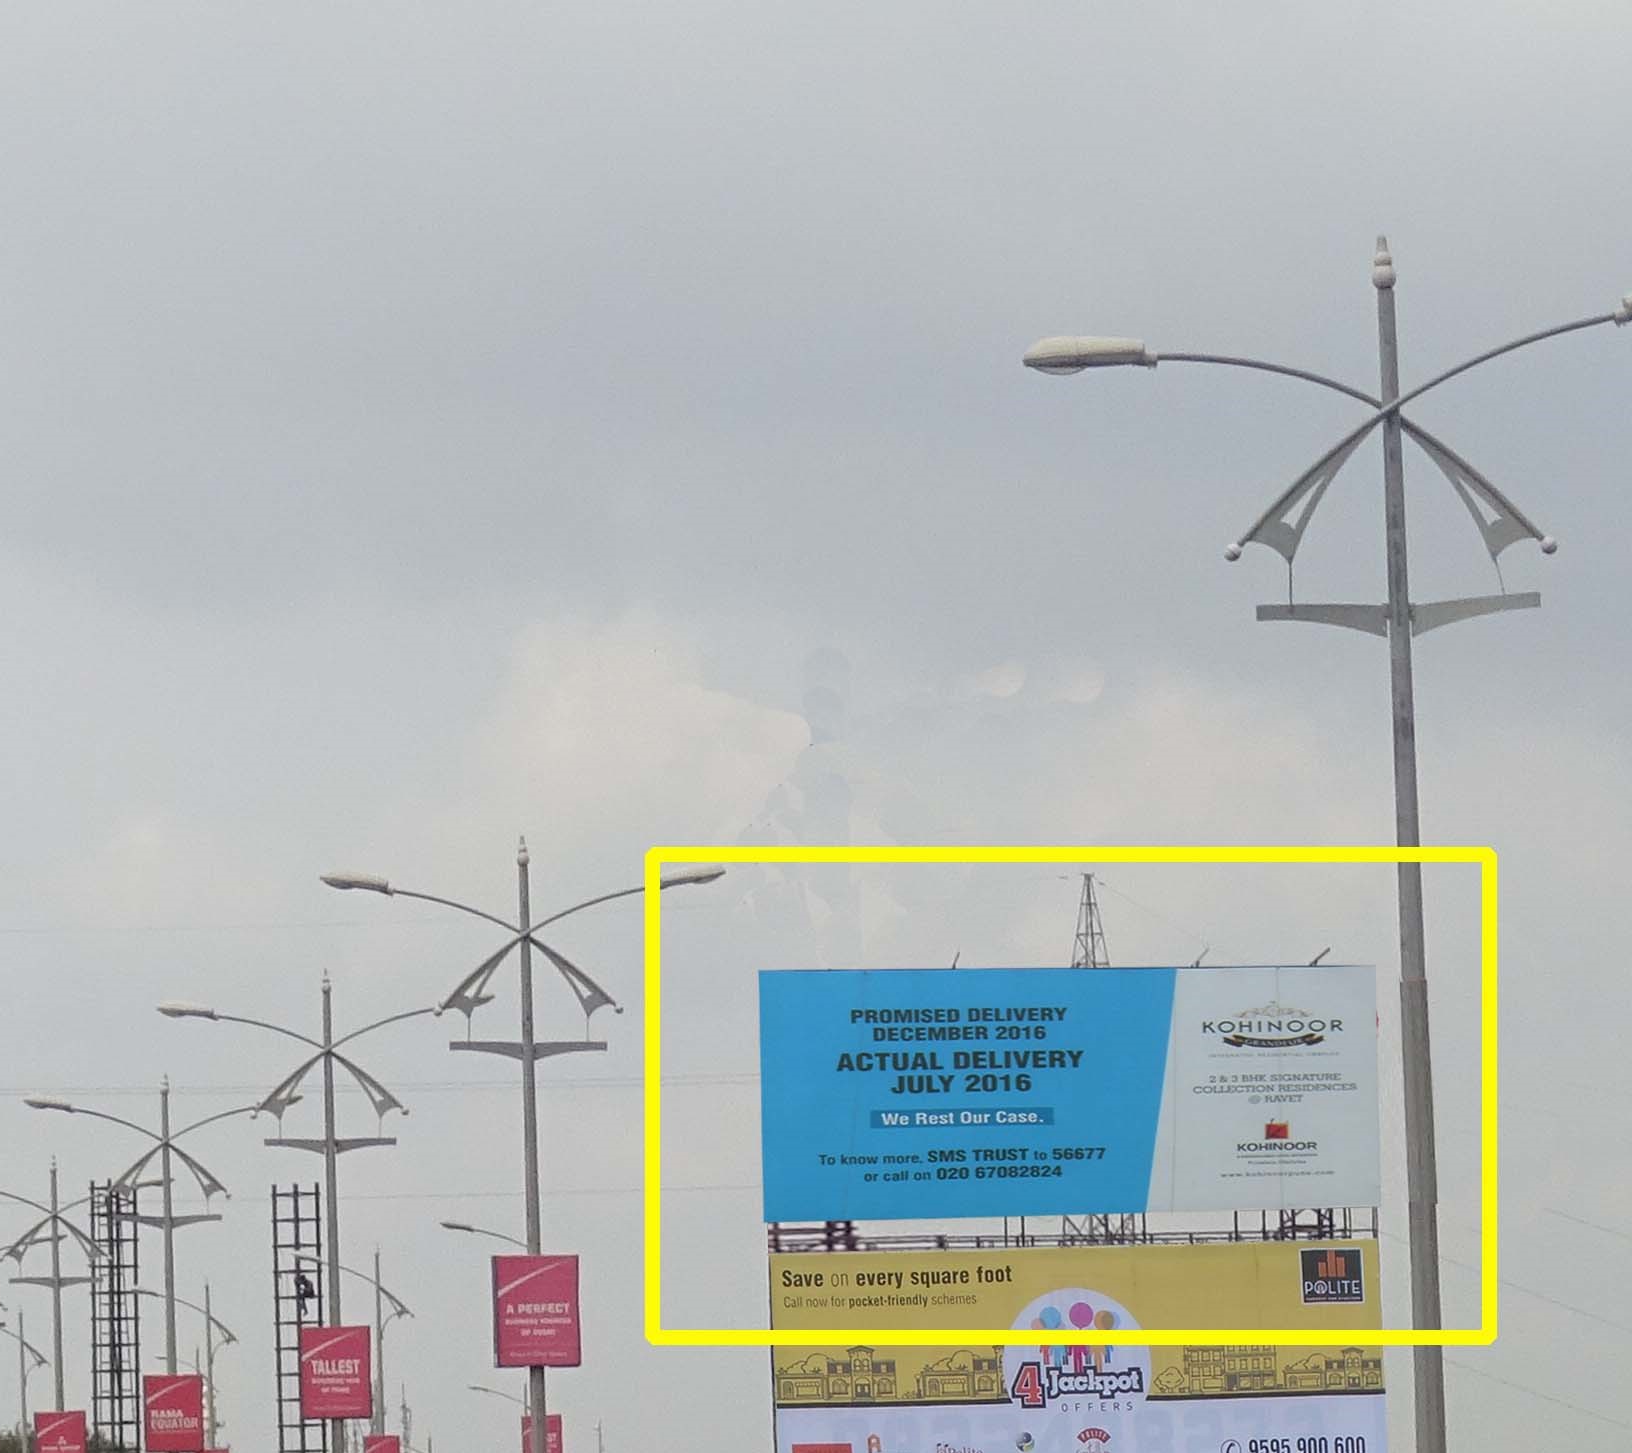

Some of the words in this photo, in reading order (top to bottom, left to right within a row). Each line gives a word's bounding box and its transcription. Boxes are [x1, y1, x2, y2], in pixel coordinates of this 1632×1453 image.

[850, 1008, 960, 1024] PROMISED
[968, 1007, 1068, 1022] DELIVERY
[873, 1026, 988, 1042] DECEMBER
[995, 1025, 1046, 1040] 2016
[1202, 1019, 1344, 1034] KOHINOOR
[836, 1052, 944, 1072] ACTUAL
[953, 1050, 1085, 1070] DELIVERY
[891, 1075, 955, 1094] JULY
[965, 1074, 1032, 1092] 2016
[1241, 1073, 1267, 1082] BHK
[1270, 1073, 1341, 1082] SIGNATURE
[1193, 1084, 1274, 1094] COLLECTION
[1278, 1082, 1357, 1092] RESIDENCES
[1265, 1095, 1303, 1103] RAVET
[881, 1113, 909, 1126] We
[916, 1112, 954, 1125] Rest
[960, 1111, 990, 1124] Our
[995, 1110, 1045, 1124] Case.
[1237, 1142, 1318, 1152] KOHINOOR
[819, 1155, 836, 1166] To
[840, 1153, 878, 1165] know
[927, 1150, 967, 1164] SMS
[972, 1149, 1030, 1162] TRUST
[1033, 1150, 1048, 1161] to
[1052, 1148, 1106, 1161] 56677
[864, 1172, 878, 1182] or
[883, 1170, 909, 1182] call
[914, 1171, 931, 1181] on
[936, 1167, 969, 1180] 020
[975, 1165, 1063, 1179] 67082824
[782, 1270, 824, 1288] Save
[831, 1274, 849, 1287] on
[856, 1271, 903, 1289] every
[911, 1269, 969, 1288] square
[977, 1265, 1013, 1284] foot
[1304, 1280, 1361, 1295] POLITE
[507, 1304, 514, 1314] A
[518, 1302, 569, 1314] PERFECT
[784, 1296, 803, 1308] Call
[806, 1297, 830, 1308] now
[831, 1295, 846, 1308] for
[849, 1293, 928, 1309] pocket-friendly
[931, 1293, 977, 1305] schemes
[311, 1359, 360, 1375] TALLEST
[1013, 1363, 1045, 1407] 4
[1049, 1368, 1141, 1397] Jackpot
[1061, 1401, 1133, 1413] OFFERS
